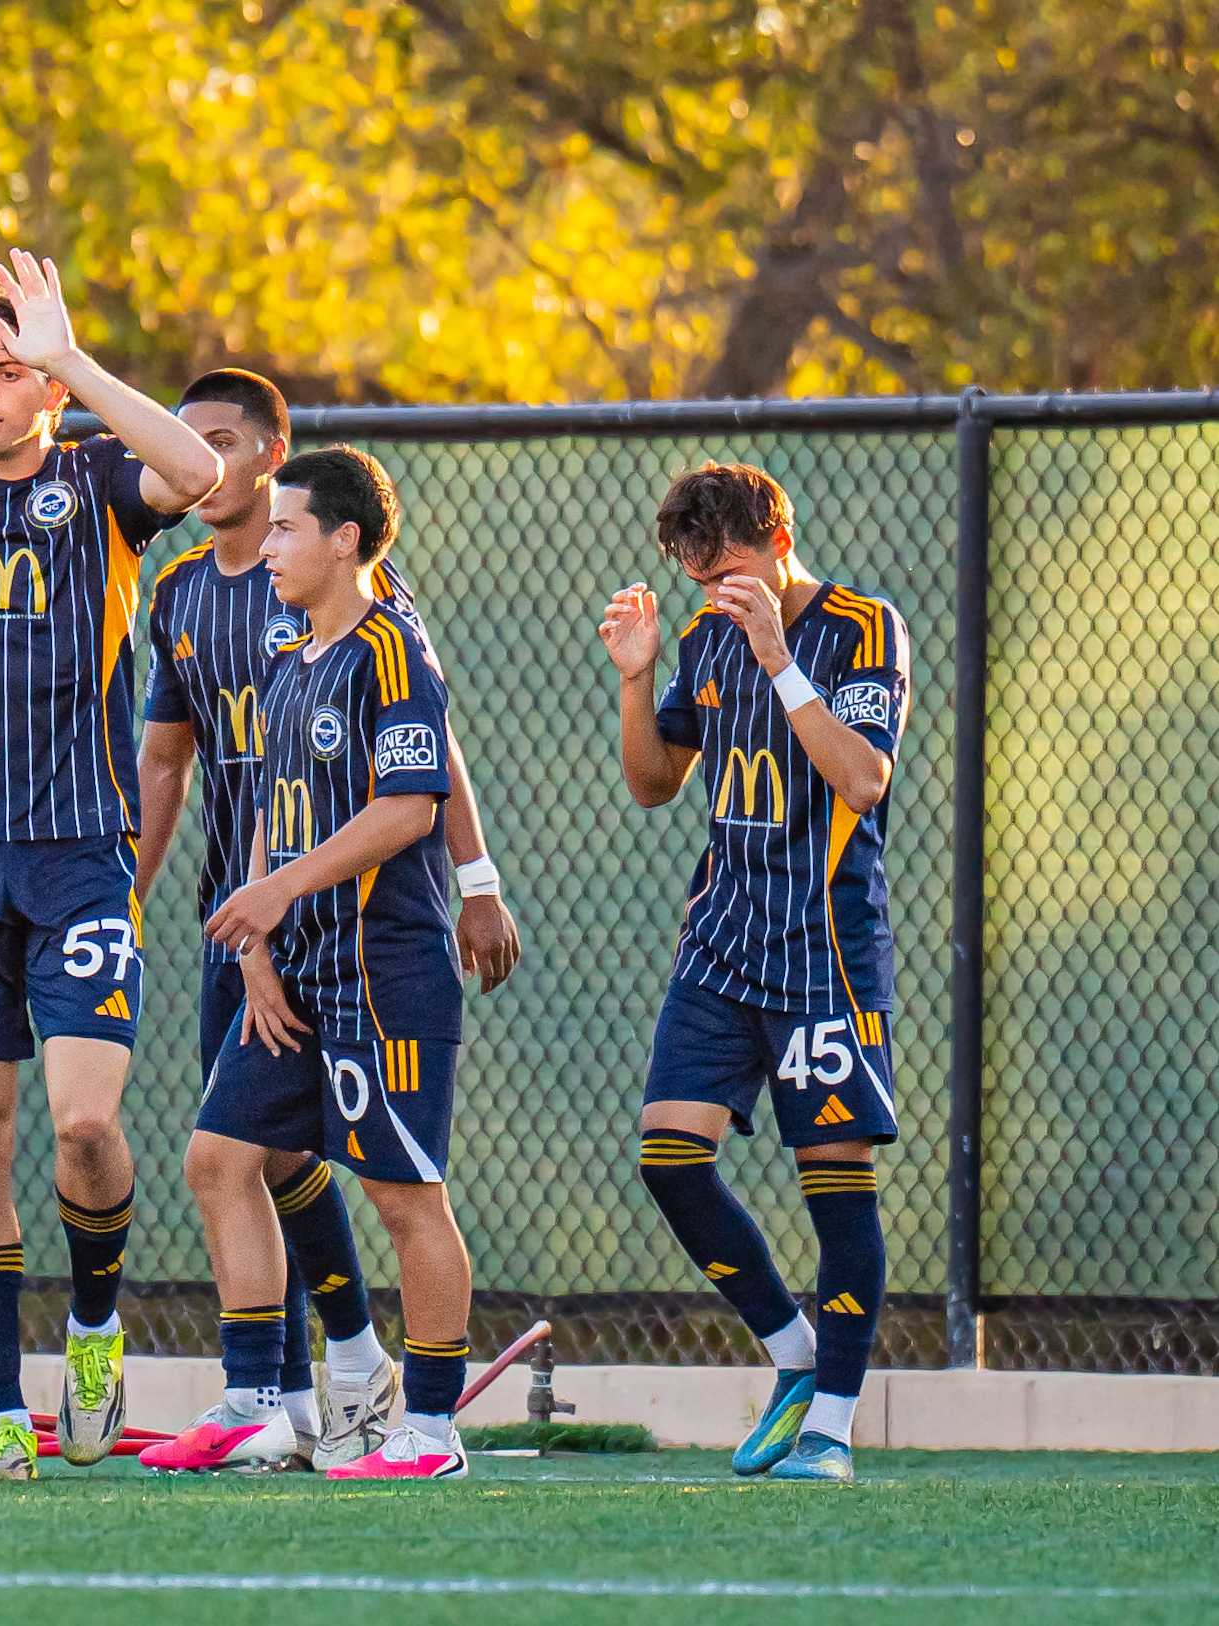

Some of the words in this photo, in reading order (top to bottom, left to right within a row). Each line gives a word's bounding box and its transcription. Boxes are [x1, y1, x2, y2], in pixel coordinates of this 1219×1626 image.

[849, 702, 886, 721] PRO
[382, 728, 429, 749] NEXT
[391, 747, 433, 765] PRO
[62, 917, 135, 981] 57
[776, 1018, 854, 1091] 45
